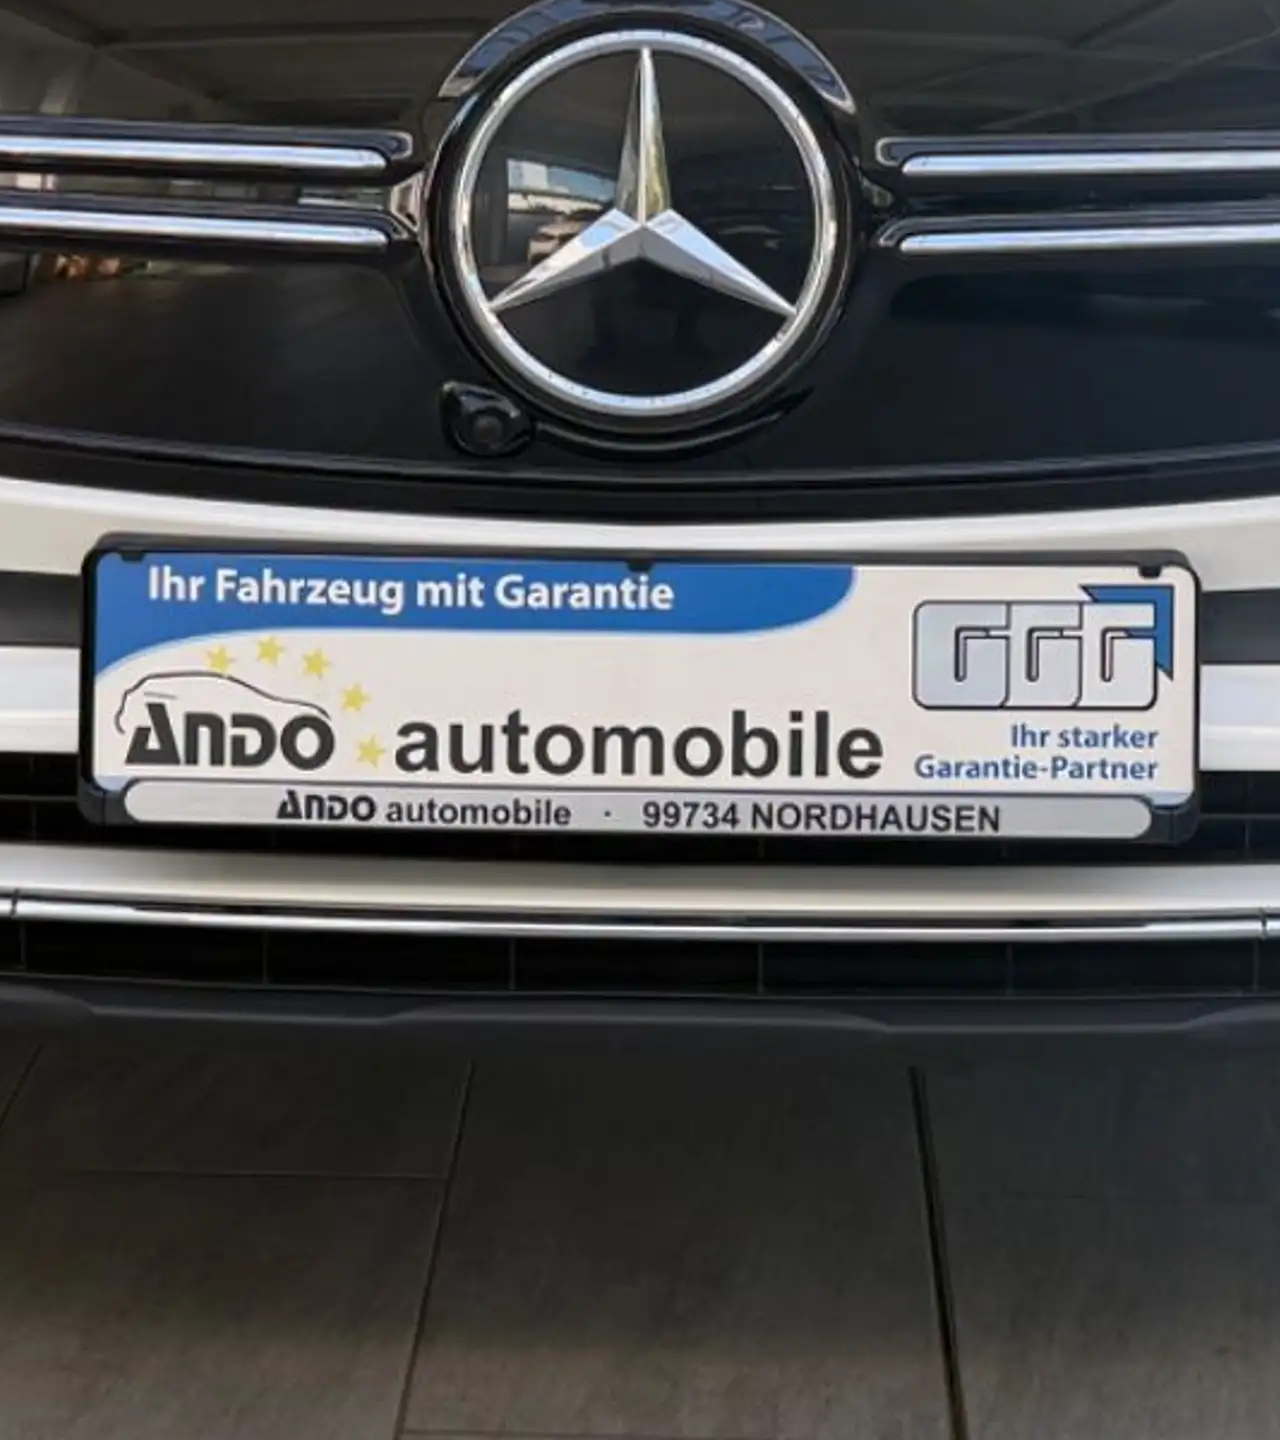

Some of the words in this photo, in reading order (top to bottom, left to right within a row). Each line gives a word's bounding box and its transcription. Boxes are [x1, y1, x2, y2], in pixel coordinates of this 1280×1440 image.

[148, 566, 206, 600] Ihr
[216, 569, 405, 614] Fahrzeug
[417, 573, 485, 608] mit
[495, 574, 675, 610] Garantie
[394, 709, 884, 779] automobile
[1010, 723, 1050, 748] Ihr
[1057, 722, 1159, 749] starker
[913, 753, 1159, 780] Garantie-Partner
[385, 797, 571, 827] automobile
[642, 800, 740, 829] 99734
[750, 802, 1001, 833] NORDHAUSEN
